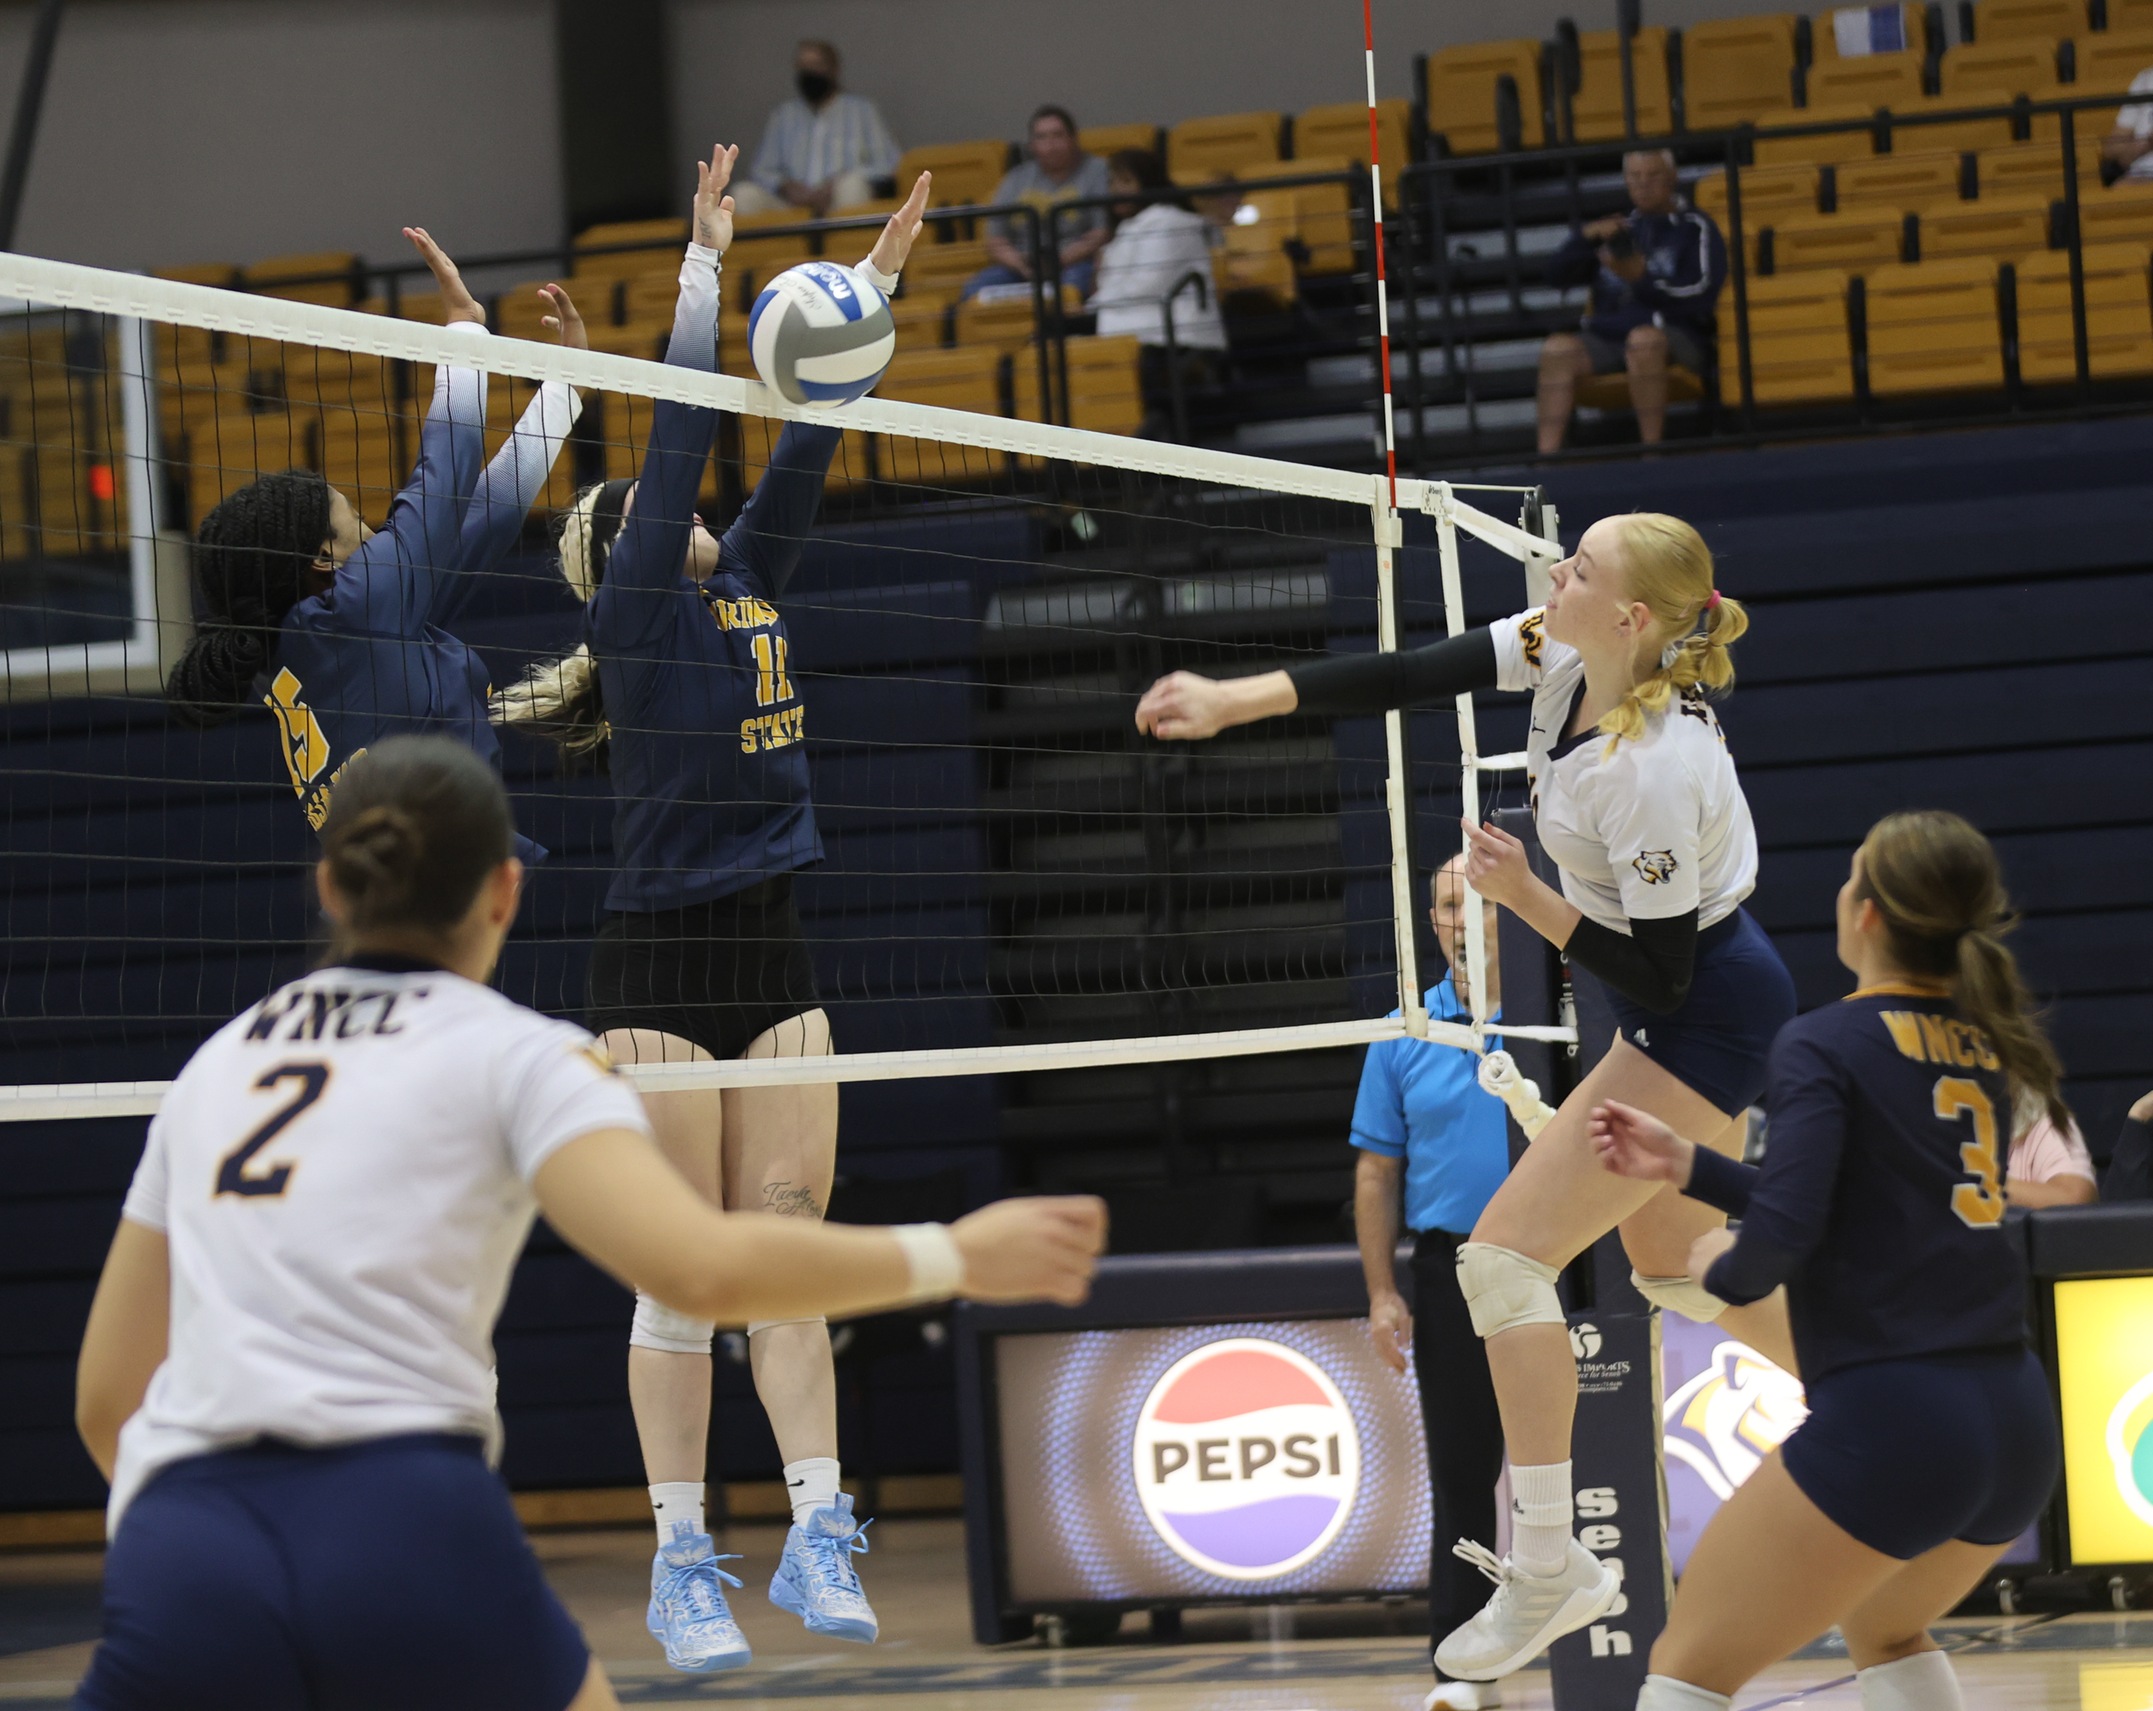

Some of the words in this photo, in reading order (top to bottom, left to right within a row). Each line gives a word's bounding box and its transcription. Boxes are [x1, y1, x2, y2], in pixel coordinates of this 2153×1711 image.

[750, 632, 795, 707] 11
[263, 666, 331, 800] 15
[740, 704, 804, 754] STATE
[212, 1057, 332, 1199] 2
[1932, 1075, 2006, 1229] 3
[1152, 1432, 1342, 1484] PEPSI
